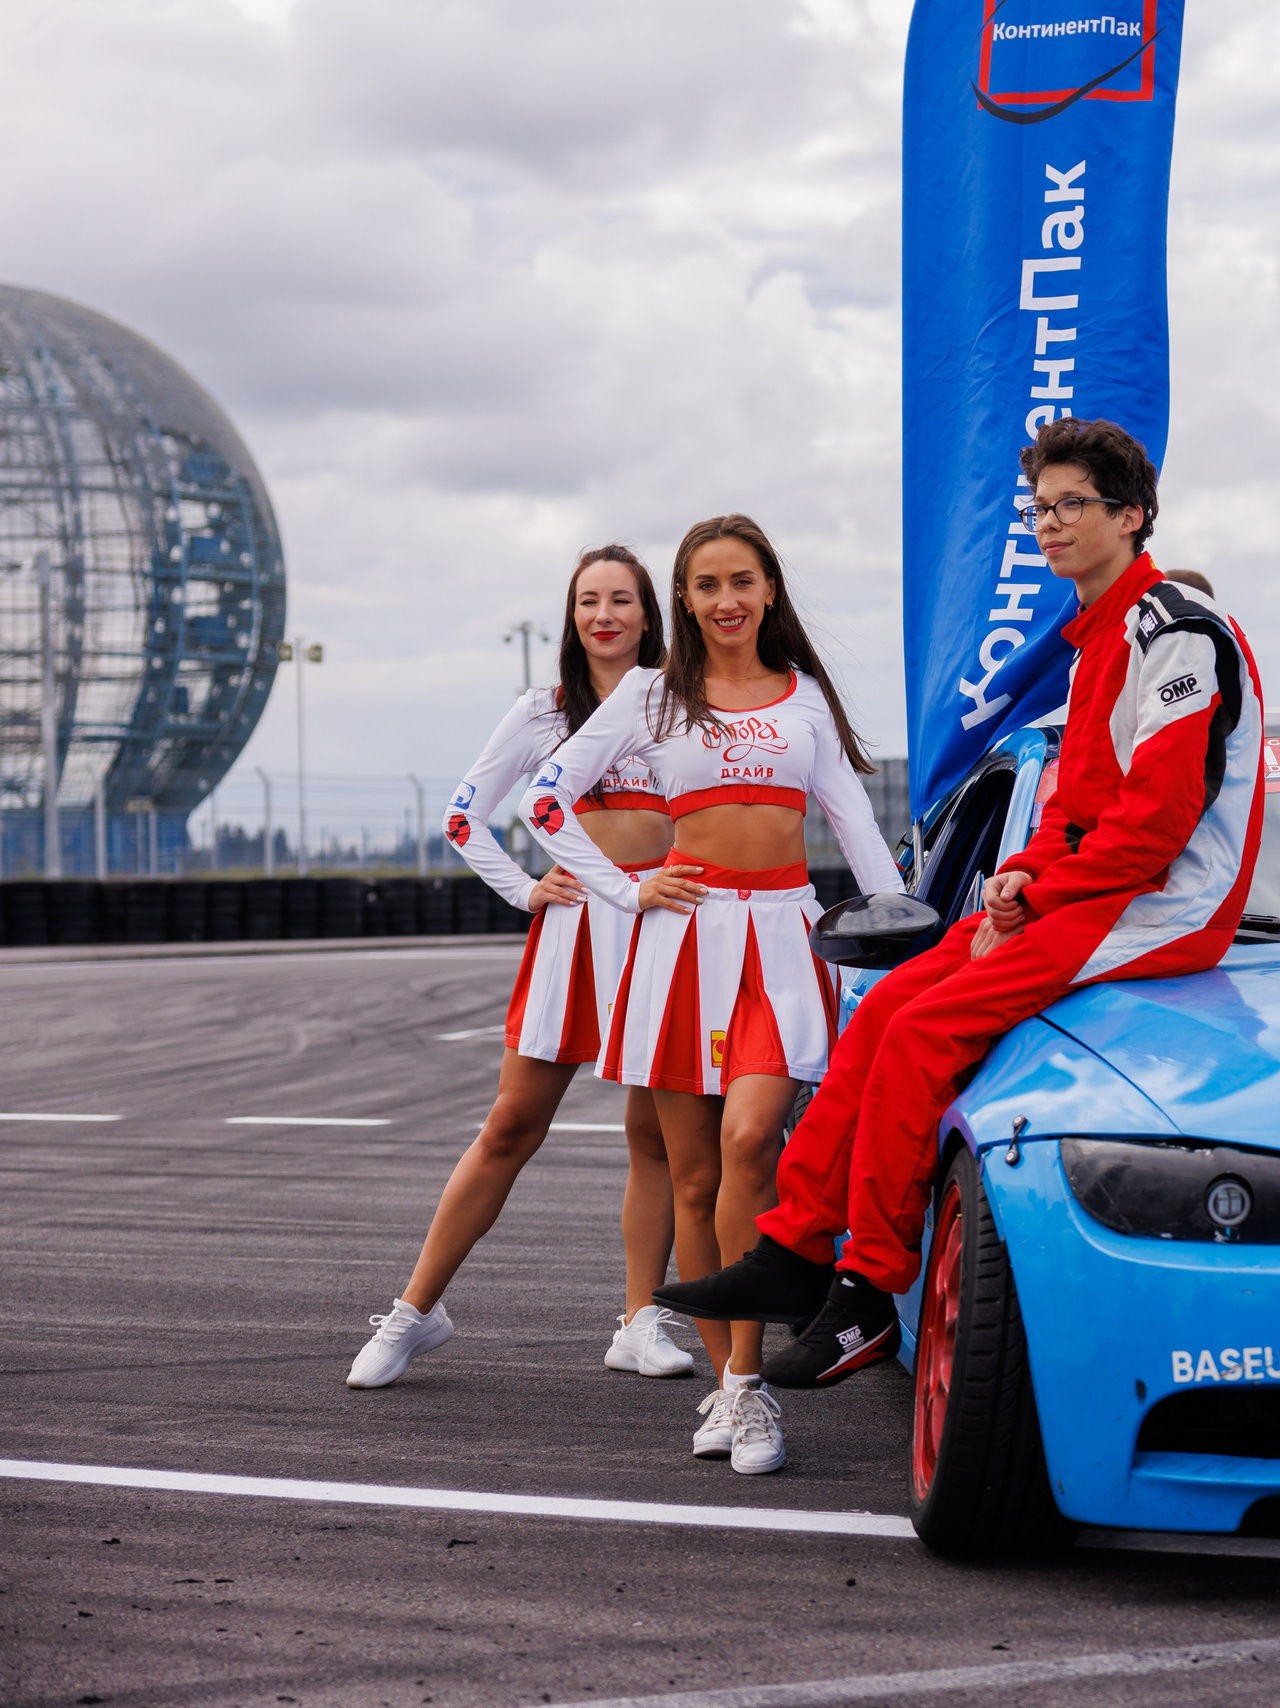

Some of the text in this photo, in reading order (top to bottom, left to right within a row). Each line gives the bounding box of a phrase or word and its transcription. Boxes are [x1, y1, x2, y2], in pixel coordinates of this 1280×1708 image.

[992, 15, 1142, 41] КонтинентПак
[1140, 612, 1156, 634] OMP
[1160, 676, 1198, 703] OMP
[721, 764, 774, 779] ДРАЙВ
[603, 776, 648, 788] ДРАЙВ
[838, 1327, 862, 1346] OMP
